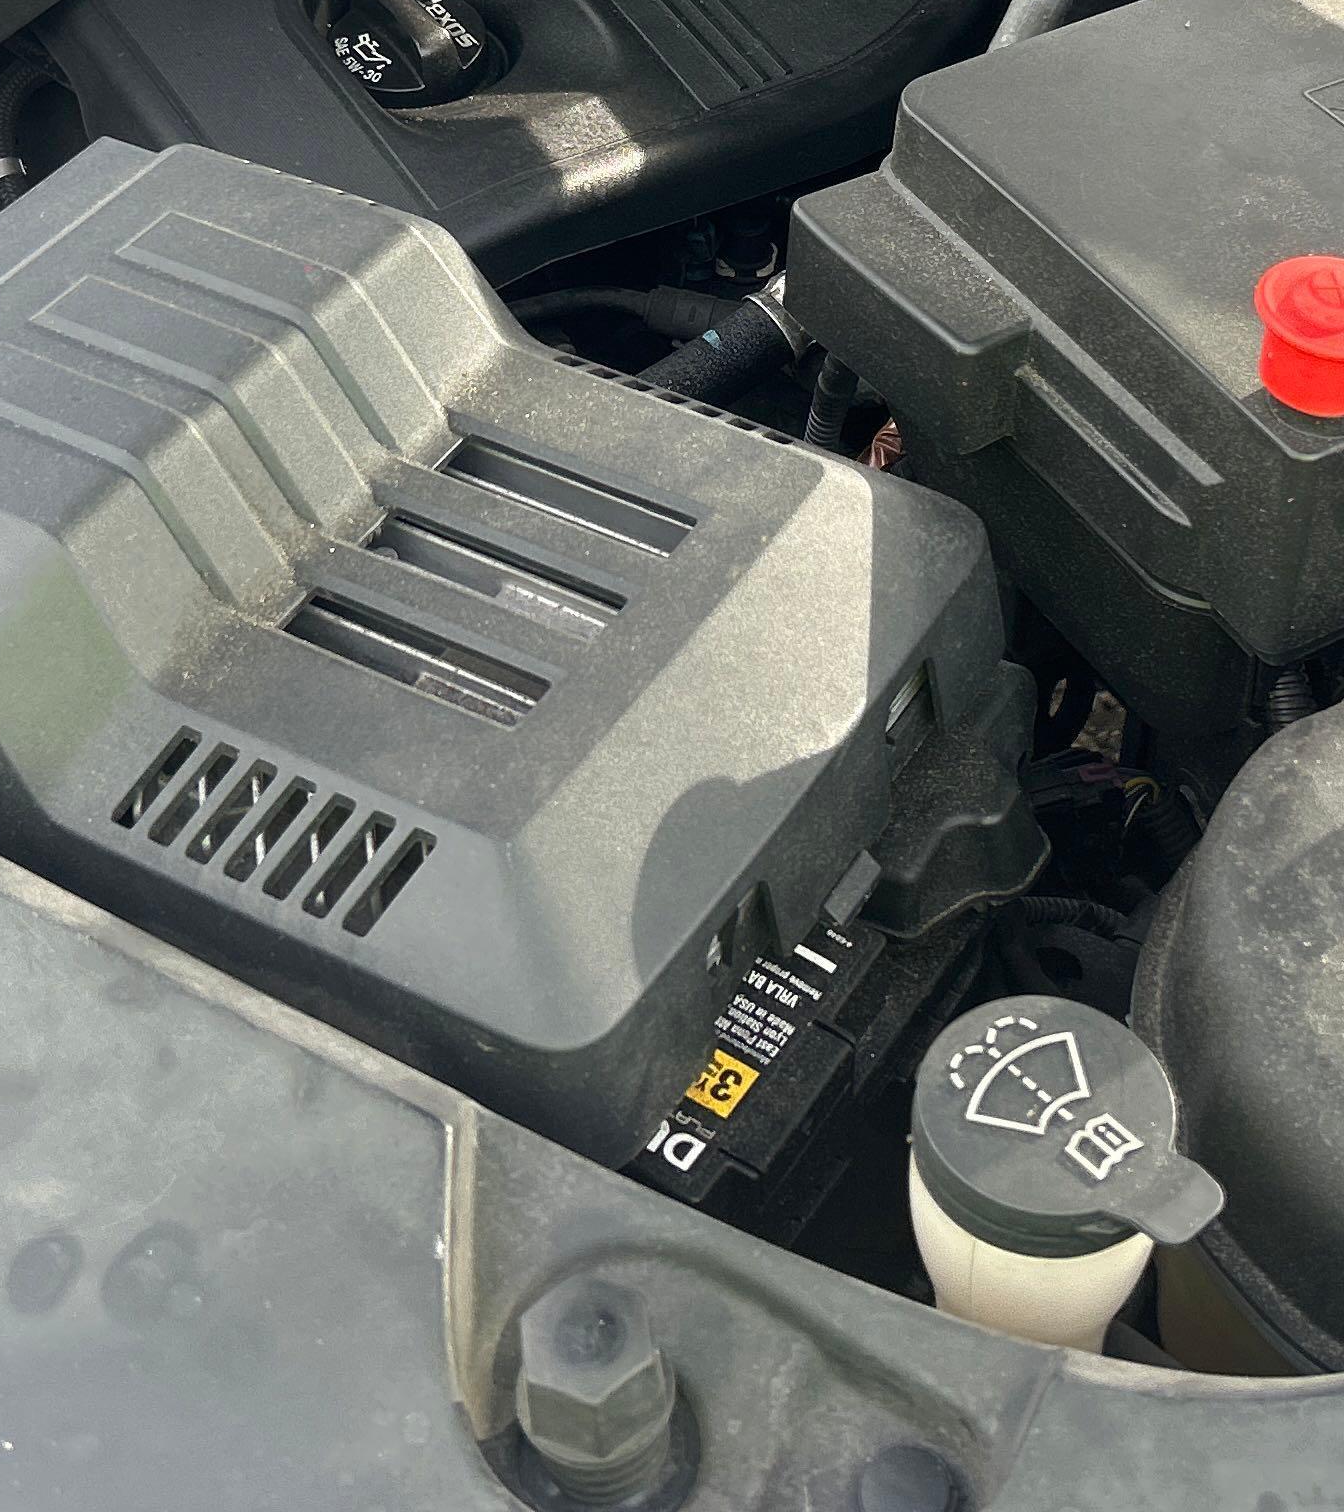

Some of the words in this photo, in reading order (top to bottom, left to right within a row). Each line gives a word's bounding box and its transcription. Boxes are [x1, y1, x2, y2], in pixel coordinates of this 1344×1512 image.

[334, 37, 351, 57] SAE
[343, 56, 383, 83] 5W-30
[733, 994, 756, 1014] USA
[765, 979, 799, 1009] VRLA
[755, 1007, 768, 1020] in
[766, 1014, 796, 1037] Made
[756, 1038, 780, 1058] East
[762, 1026, 789, 1048] Lyon
[710, 1069, 743, 1102] 3
